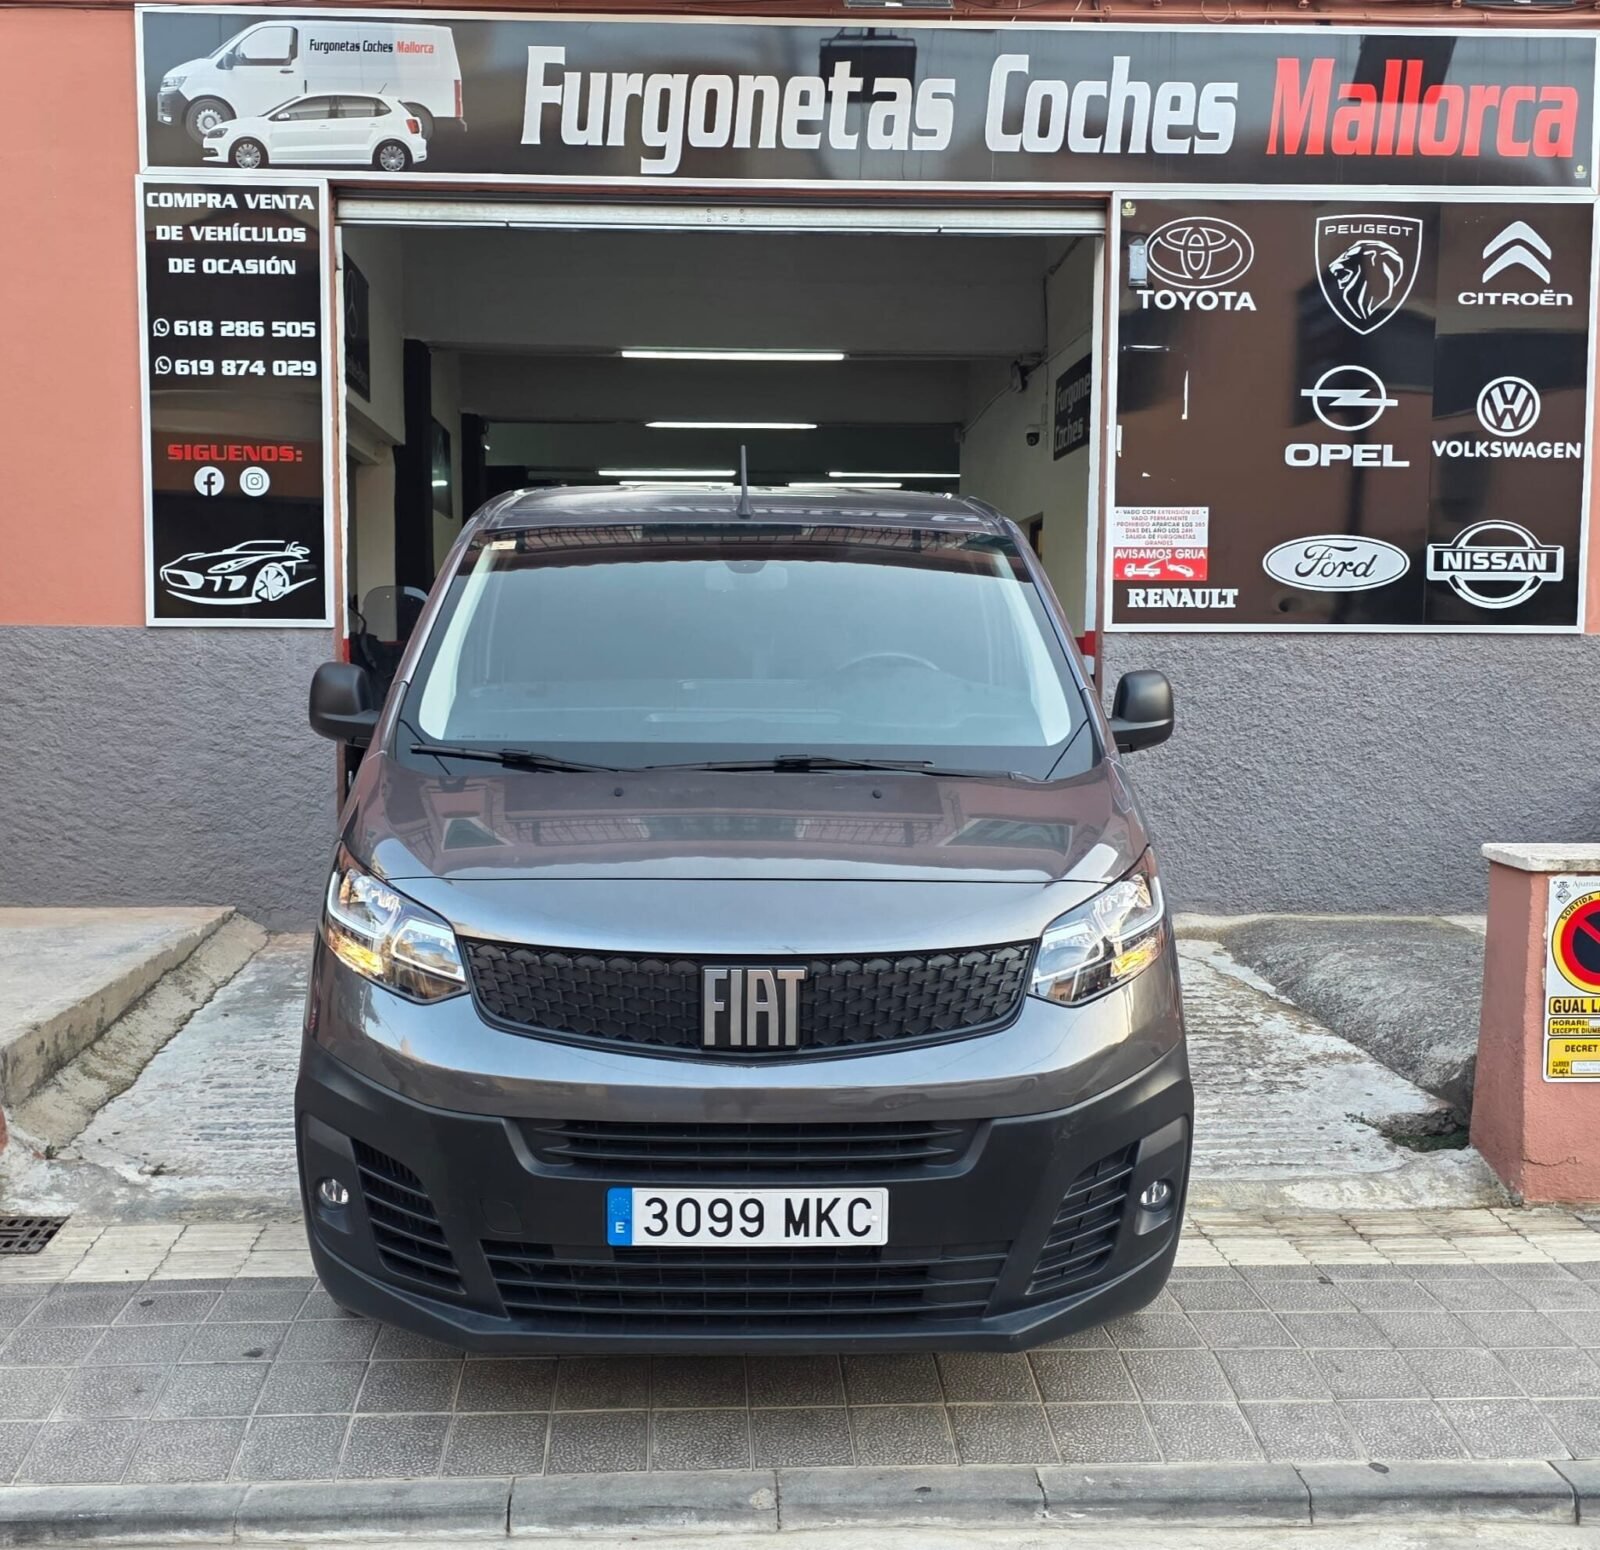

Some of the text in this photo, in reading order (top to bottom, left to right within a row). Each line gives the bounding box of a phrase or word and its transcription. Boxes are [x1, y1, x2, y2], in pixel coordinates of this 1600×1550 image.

[309, 39, 434, 54] Furgonetas Coches Mallorca
[521, 46, 1579, 175] Furgonetas Coches Mallorca
[146, 192, 315, 210] COMPRA VENTA
[156, 223, 306, 242] DE VEHÍCULOS
[1324, 223, 1414, 237] PEUGEOT
[168, 256, 296, 275] DE OCASIÓN
[1137, 289, 1257, 311] TOYOTA
[173, 320, 316, 338] 618 286 505
[174, 359, 317, 377] 619 874 029
[167, 444, 303, 462] SIGUENOS:
[1284, 443, 1411, 468] OPEL
[1431, 440, 1582, 459] VOLKSWAGEN
[1114, 548, 1207, 559] AVISAMOS GRUA
[1294, 544, 1378, 578] Ford
[1441, 550, 1547, 572] NISSAN
[1127, 588, 1239, 609] RENAULT
[1561, 895, 1594, 921] SORTIDA
[703, 968, 806, 1047] FIAT
[1553, 999, 1587, 1014] GUAL
[1564, 1045, 1598, 1053] DECRET
[615, 1197, 872, 1238] E 3099 MKC
